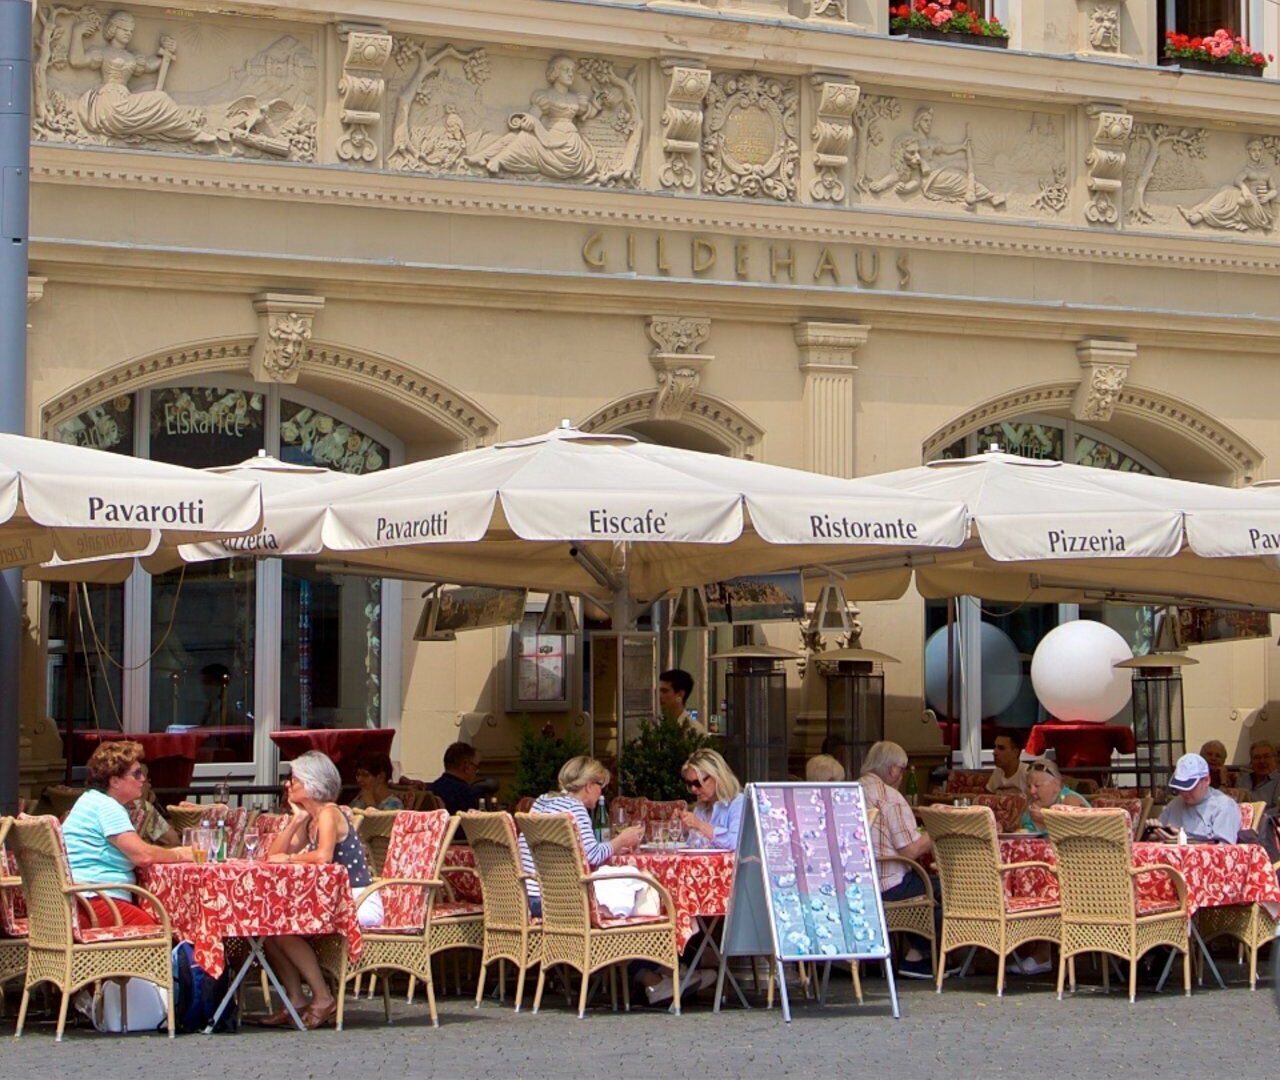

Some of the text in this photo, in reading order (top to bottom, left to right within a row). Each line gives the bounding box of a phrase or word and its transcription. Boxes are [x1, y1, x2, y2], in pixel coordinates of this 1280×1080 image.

[581, 231, 912, 288] GILDEHAUS
[88, 496, 204, 525] Pavarotti
[376, 510, 448, 541] Pavarotti
[809, 514, 918, 540] Ristorante
[1047, 528, 1126, 553] Pizzeria
